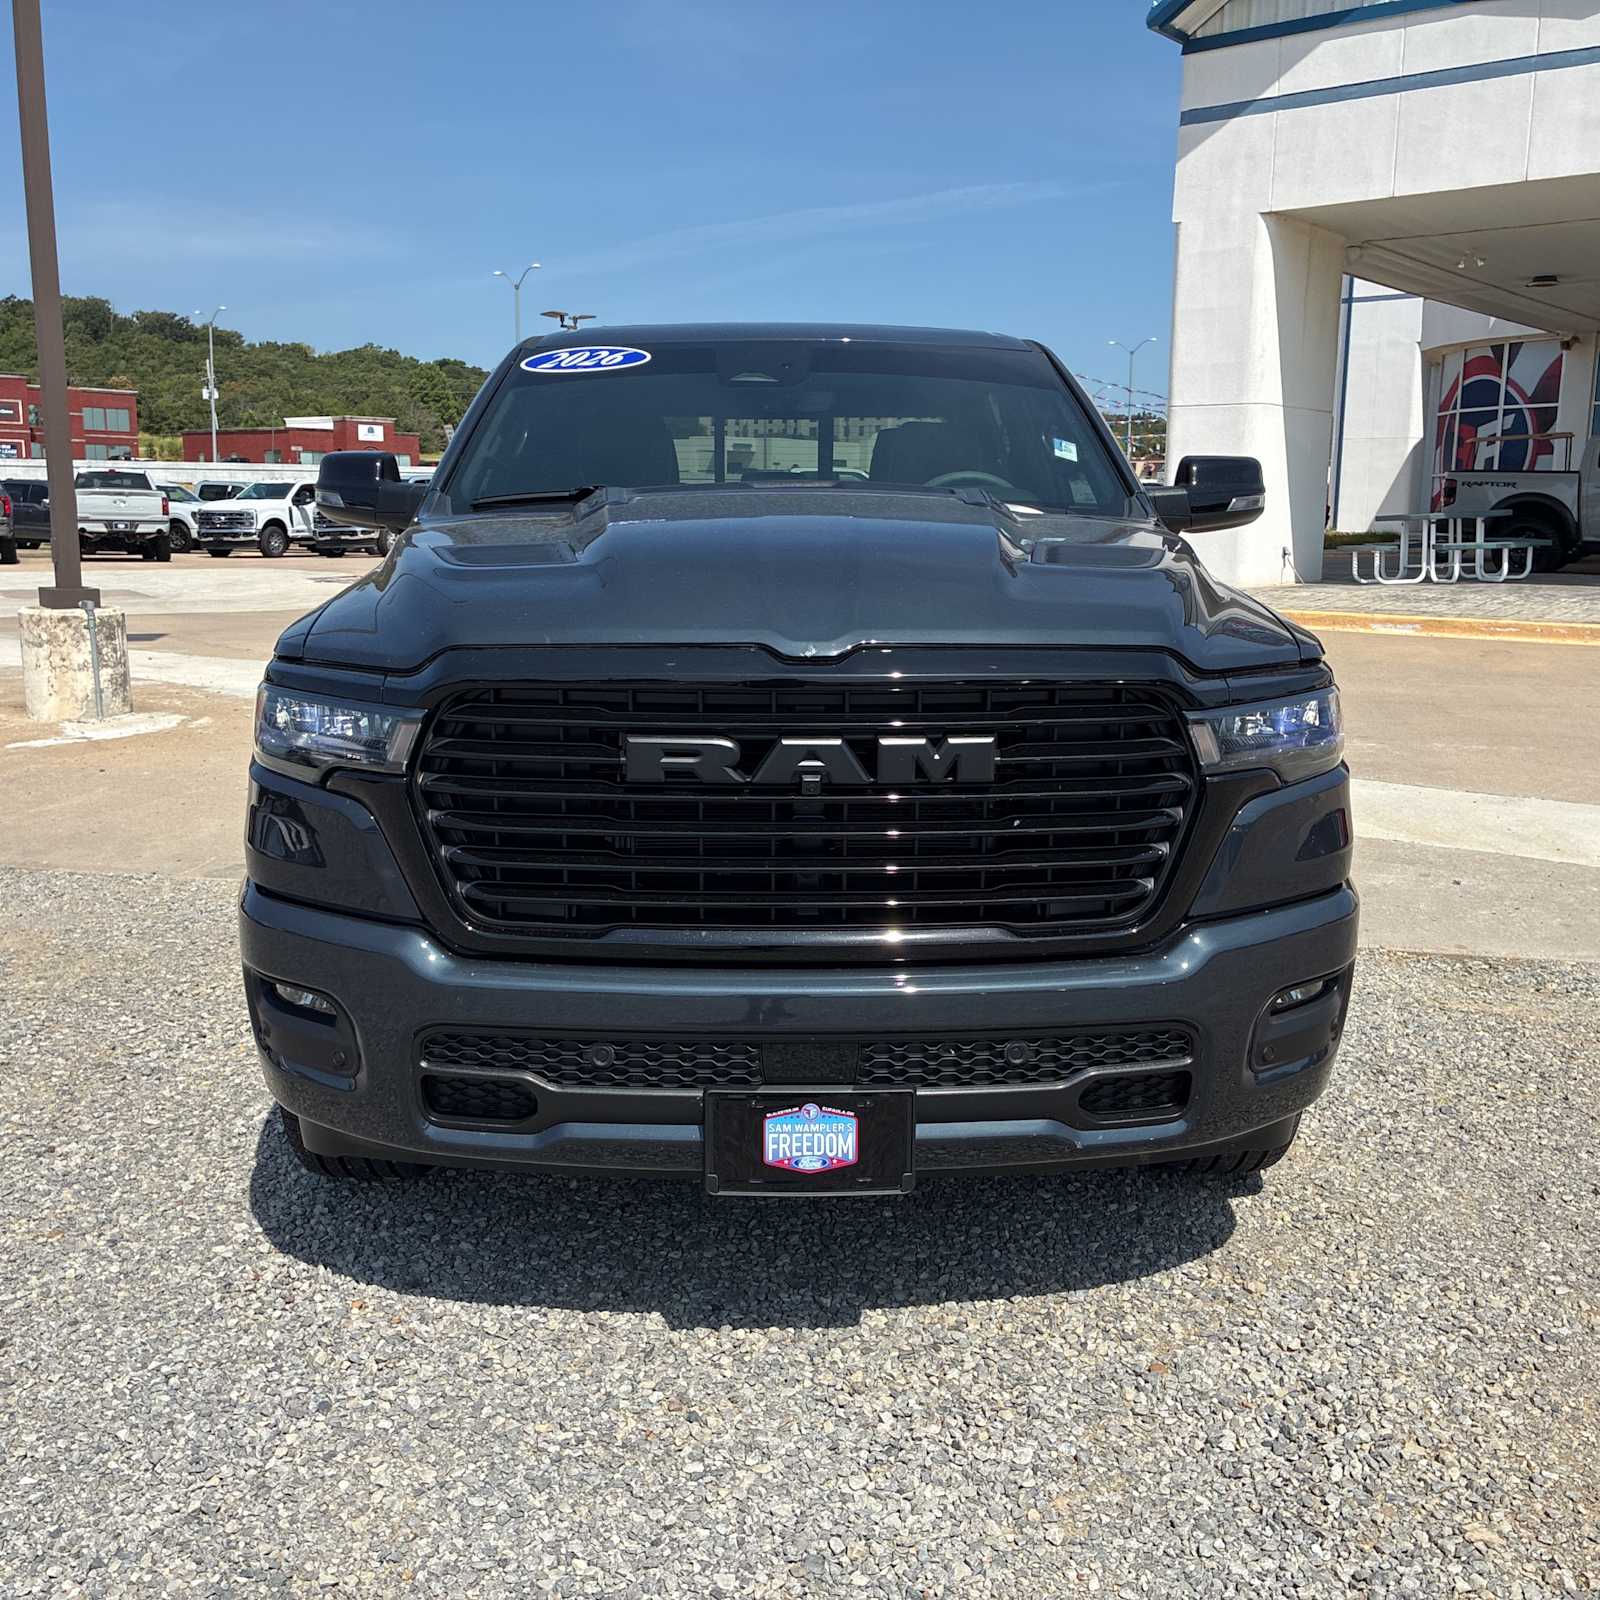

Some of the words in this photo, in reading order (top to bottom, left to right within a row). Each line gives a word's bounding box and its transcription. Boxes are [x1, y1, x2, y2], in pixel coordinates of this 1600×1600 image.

[537, 350, 633, 368] 2026
[625, 736, 996, 783] RAM
[768, 1123, 792, 1133] SAM
[768, 1133, 853, 1161] FREEDOM
